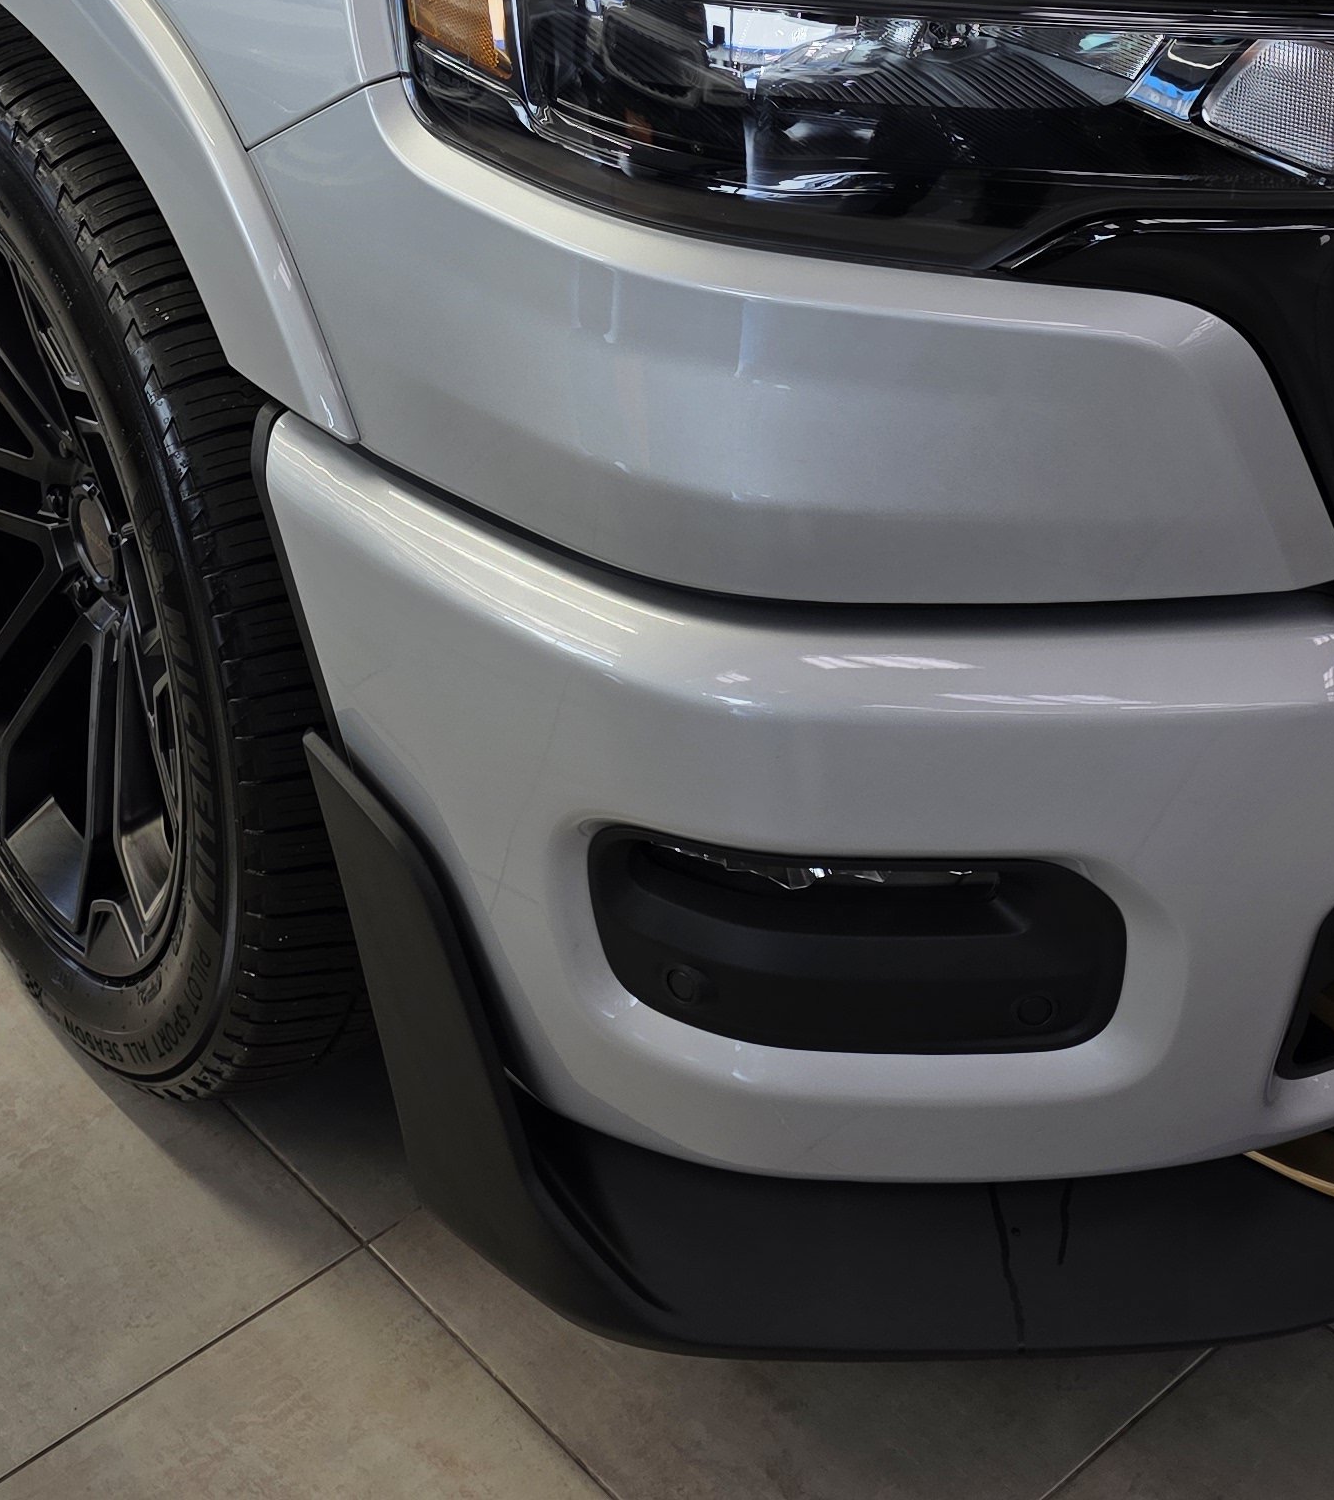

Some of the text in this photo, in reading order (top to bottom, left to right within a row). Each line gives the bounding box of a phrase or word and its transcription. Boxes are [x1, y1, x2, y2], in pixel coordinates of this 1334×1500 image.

[163, 605, 218, 917] MICHELIN
[183, 941, 213, 1016] PILOT
[64, 1017, 125, 1063] SEASON
[126, 1038, 152, 1065] ALL
[155, 1003, 192, 1059] SPORT
